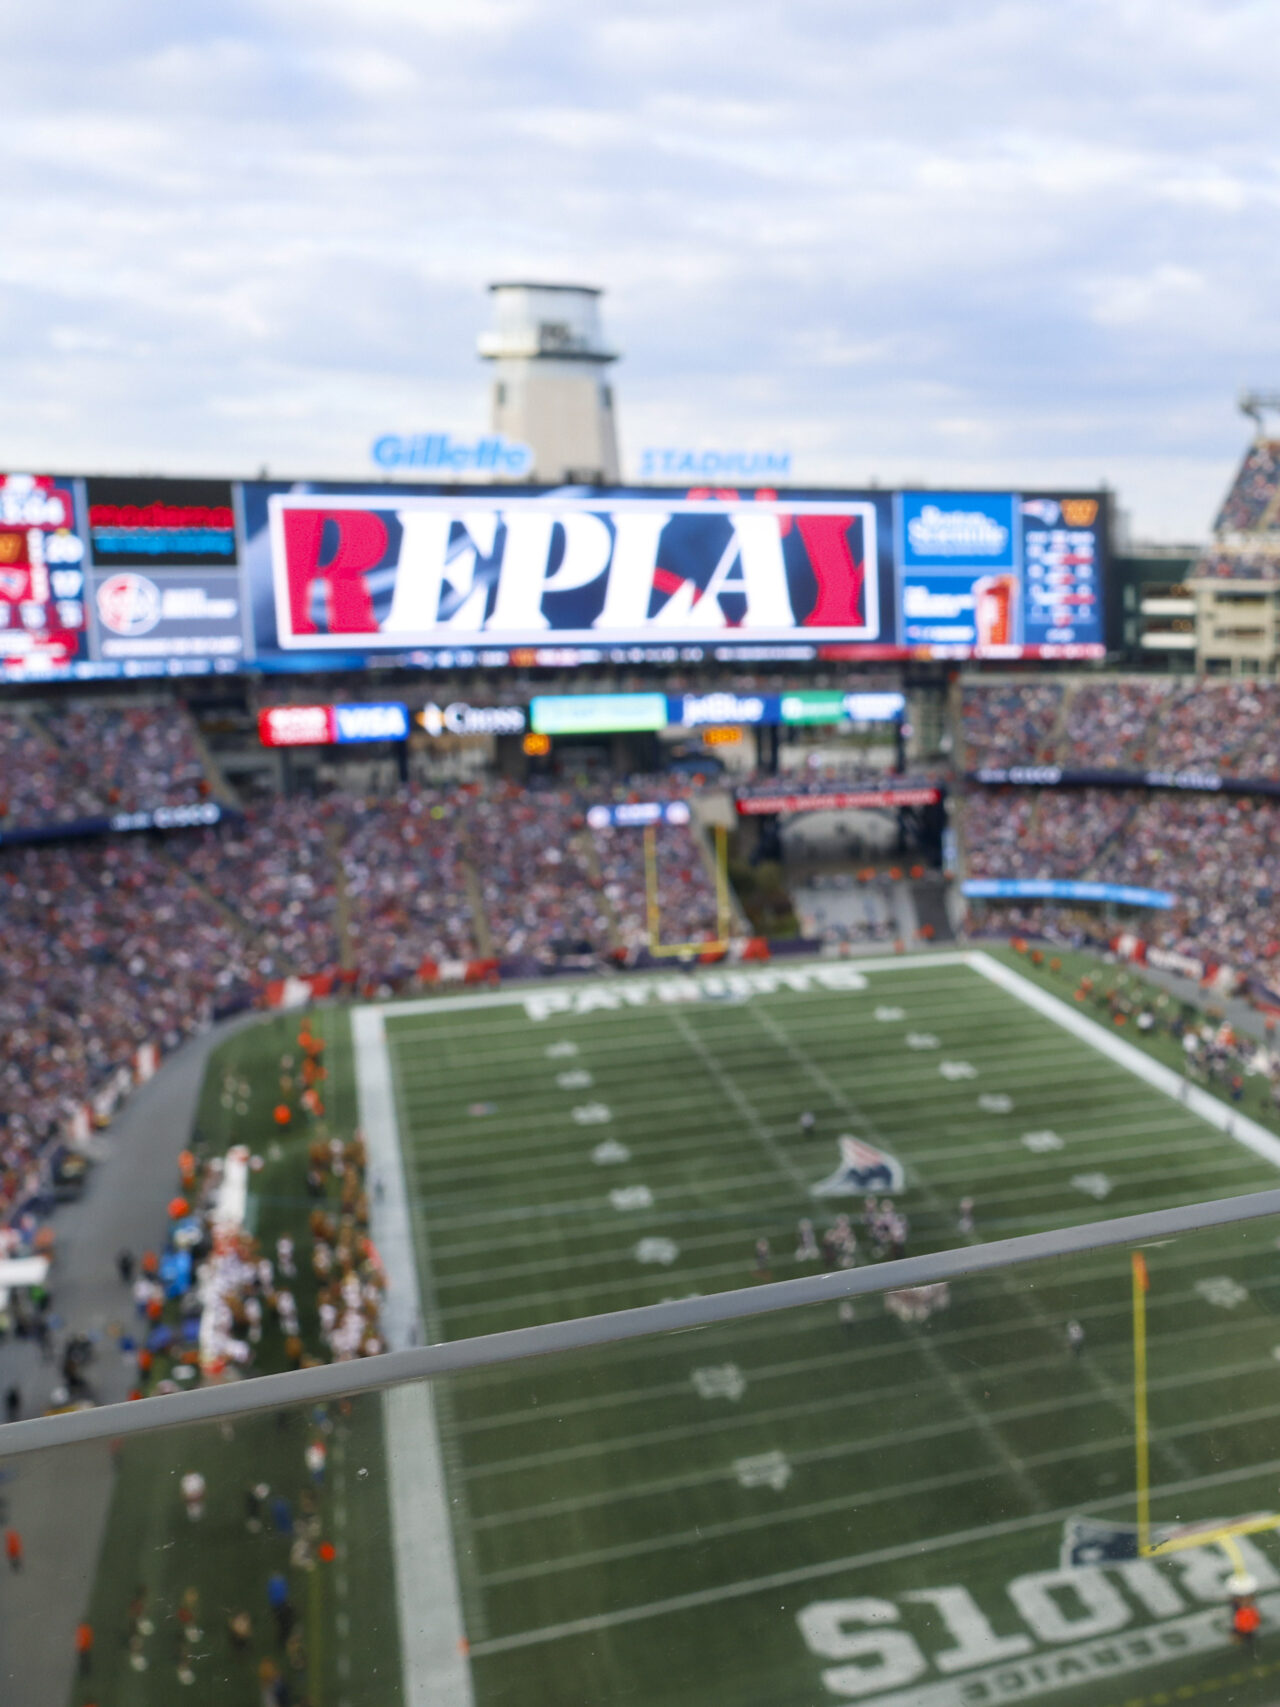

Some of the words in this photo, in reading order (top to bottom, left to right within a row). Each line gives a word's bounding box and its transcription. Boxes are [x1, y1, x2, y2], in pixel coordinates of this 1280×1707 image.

[372, 433, 533, 475] Gillette
[641, 448, 792, 477] STADIUM
[283, 508, 866, 635] REPLAY
[338, 705, 407, 739] VISA
[958, 1628, 1193, 1704] SERVICE
